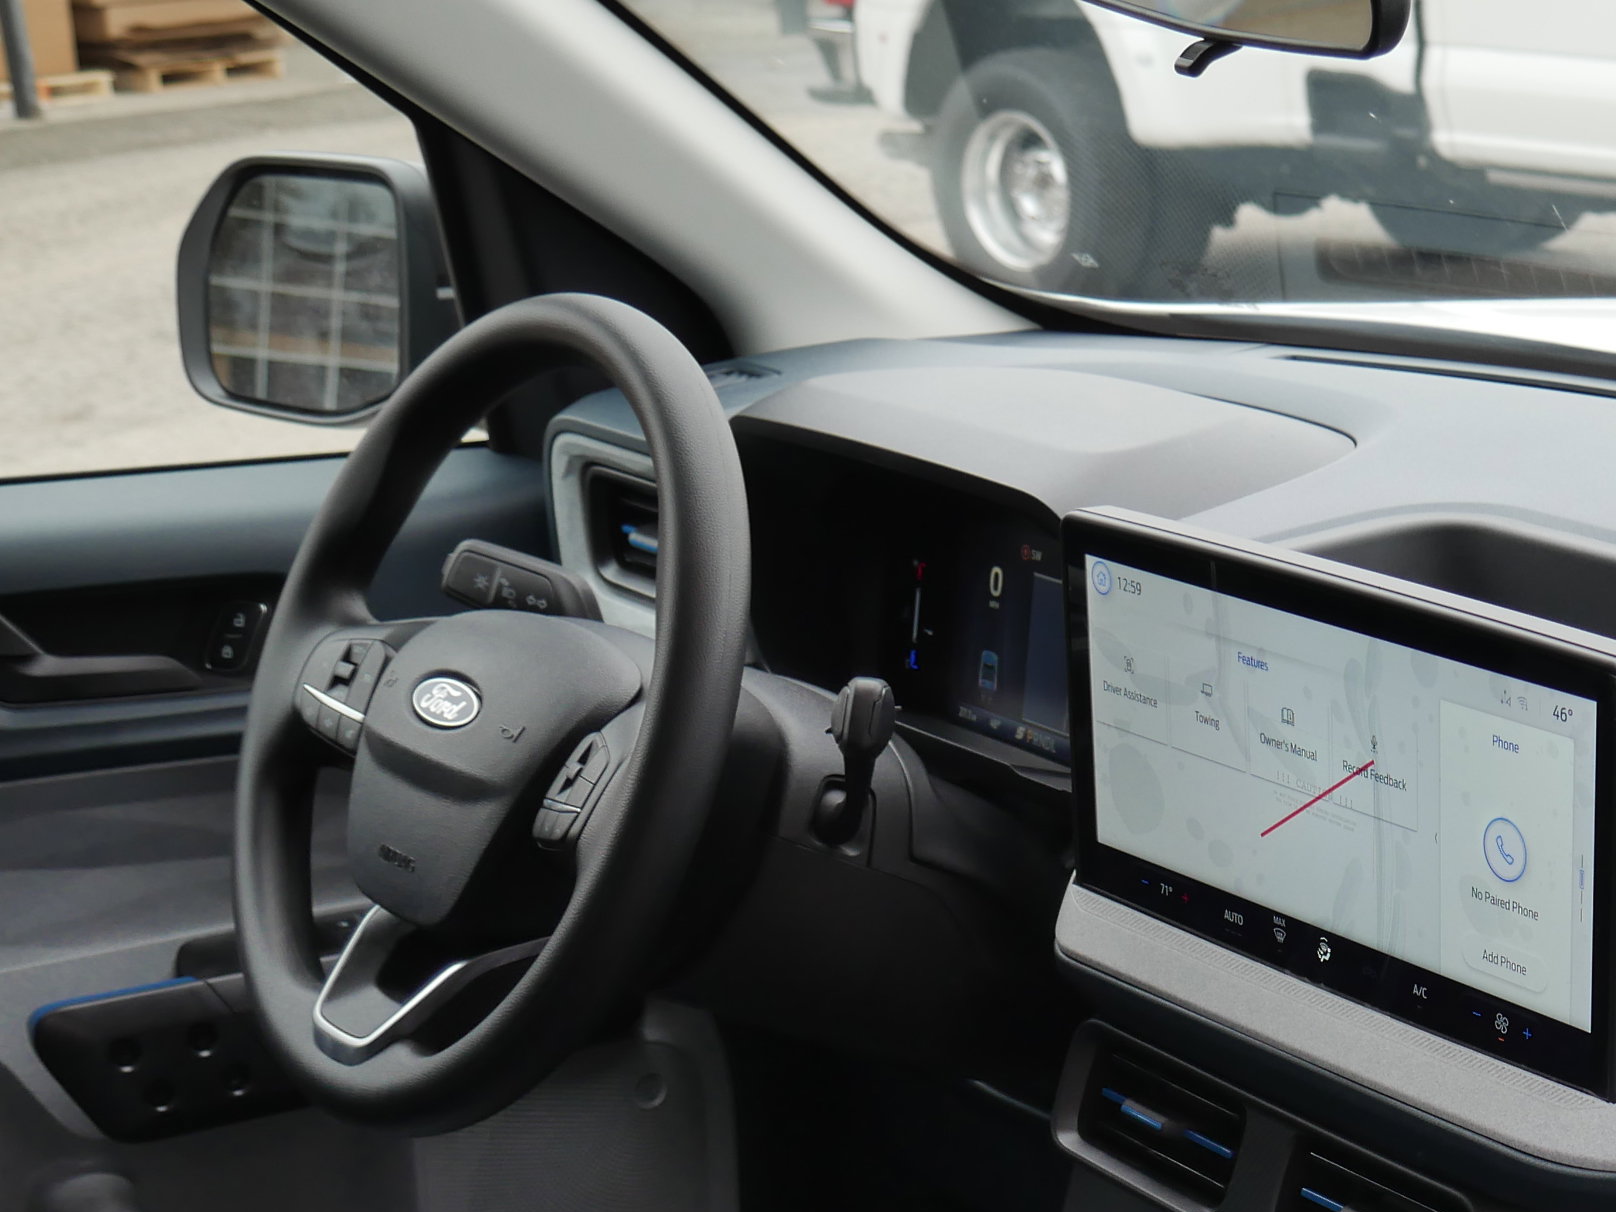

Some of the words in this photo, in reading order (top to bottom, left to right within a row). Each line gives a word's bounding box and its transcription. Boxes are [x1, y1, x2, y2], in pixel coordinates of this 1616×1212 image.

[989, 566, 1003, 597] 0
[1117, 576, 1142, 596] 12:59
[1237, 651, 1269, 672] Features
[419, 682, 468, 721] Ford
[1103, 680, 1122, 697] Driver
[1123, 688, 1158, 708] Assistance
[1195, 710, 1220, 731] Towing
[1552, 705, 1573, 722] 46°
[1259, 732, 1289, 752] Owner's
[1290, 742, 1318, 762] Manual
[1492, 734, 1520, 753] Phone
[1296, 779, 1334, 801] CAUTIN
[1370, 769, 1407, 791] Feedback
[1471, 886, 1483, 901] No
[1484, 891, 1511, 911] Paired
[1512, 901, 1539, 921] Phone
[1224, 908, 1244, 926] AUTO
[1273, 915, 1286, 928] MAX
[1482, 949, 1499, 965] Add
[1500, 955, 1527, 976] Phone
[1412, 983, 1427, 999] A/C
